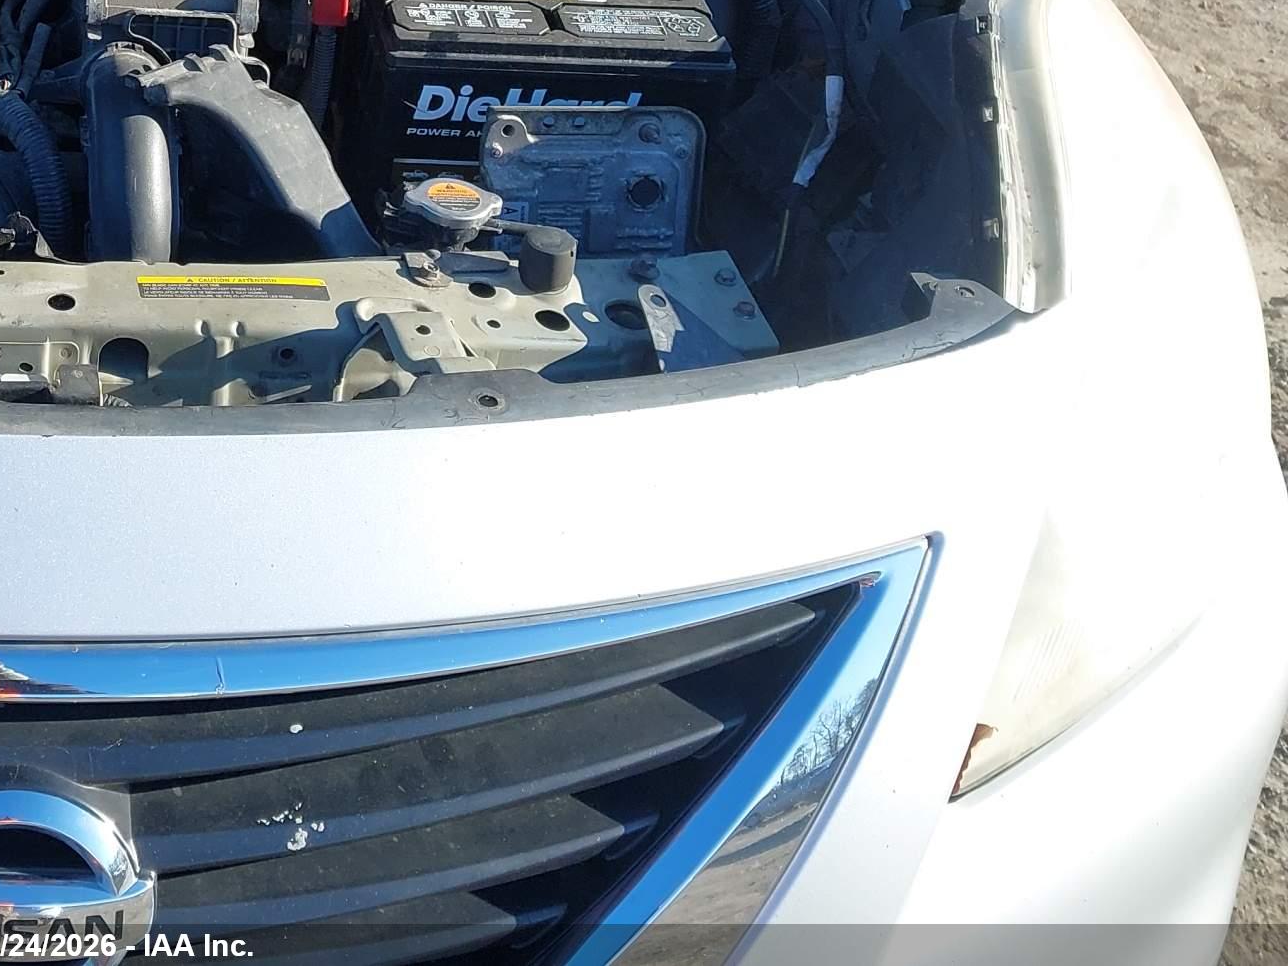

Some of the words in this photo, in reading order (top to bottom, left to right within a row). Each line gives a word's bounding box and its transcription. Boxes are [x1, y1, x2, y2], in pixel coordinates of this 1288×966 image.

[429, 2, 468, 10] DANGER
[477, 4, 513, 12] POISON
[406, 127, 461, 137] POWER
